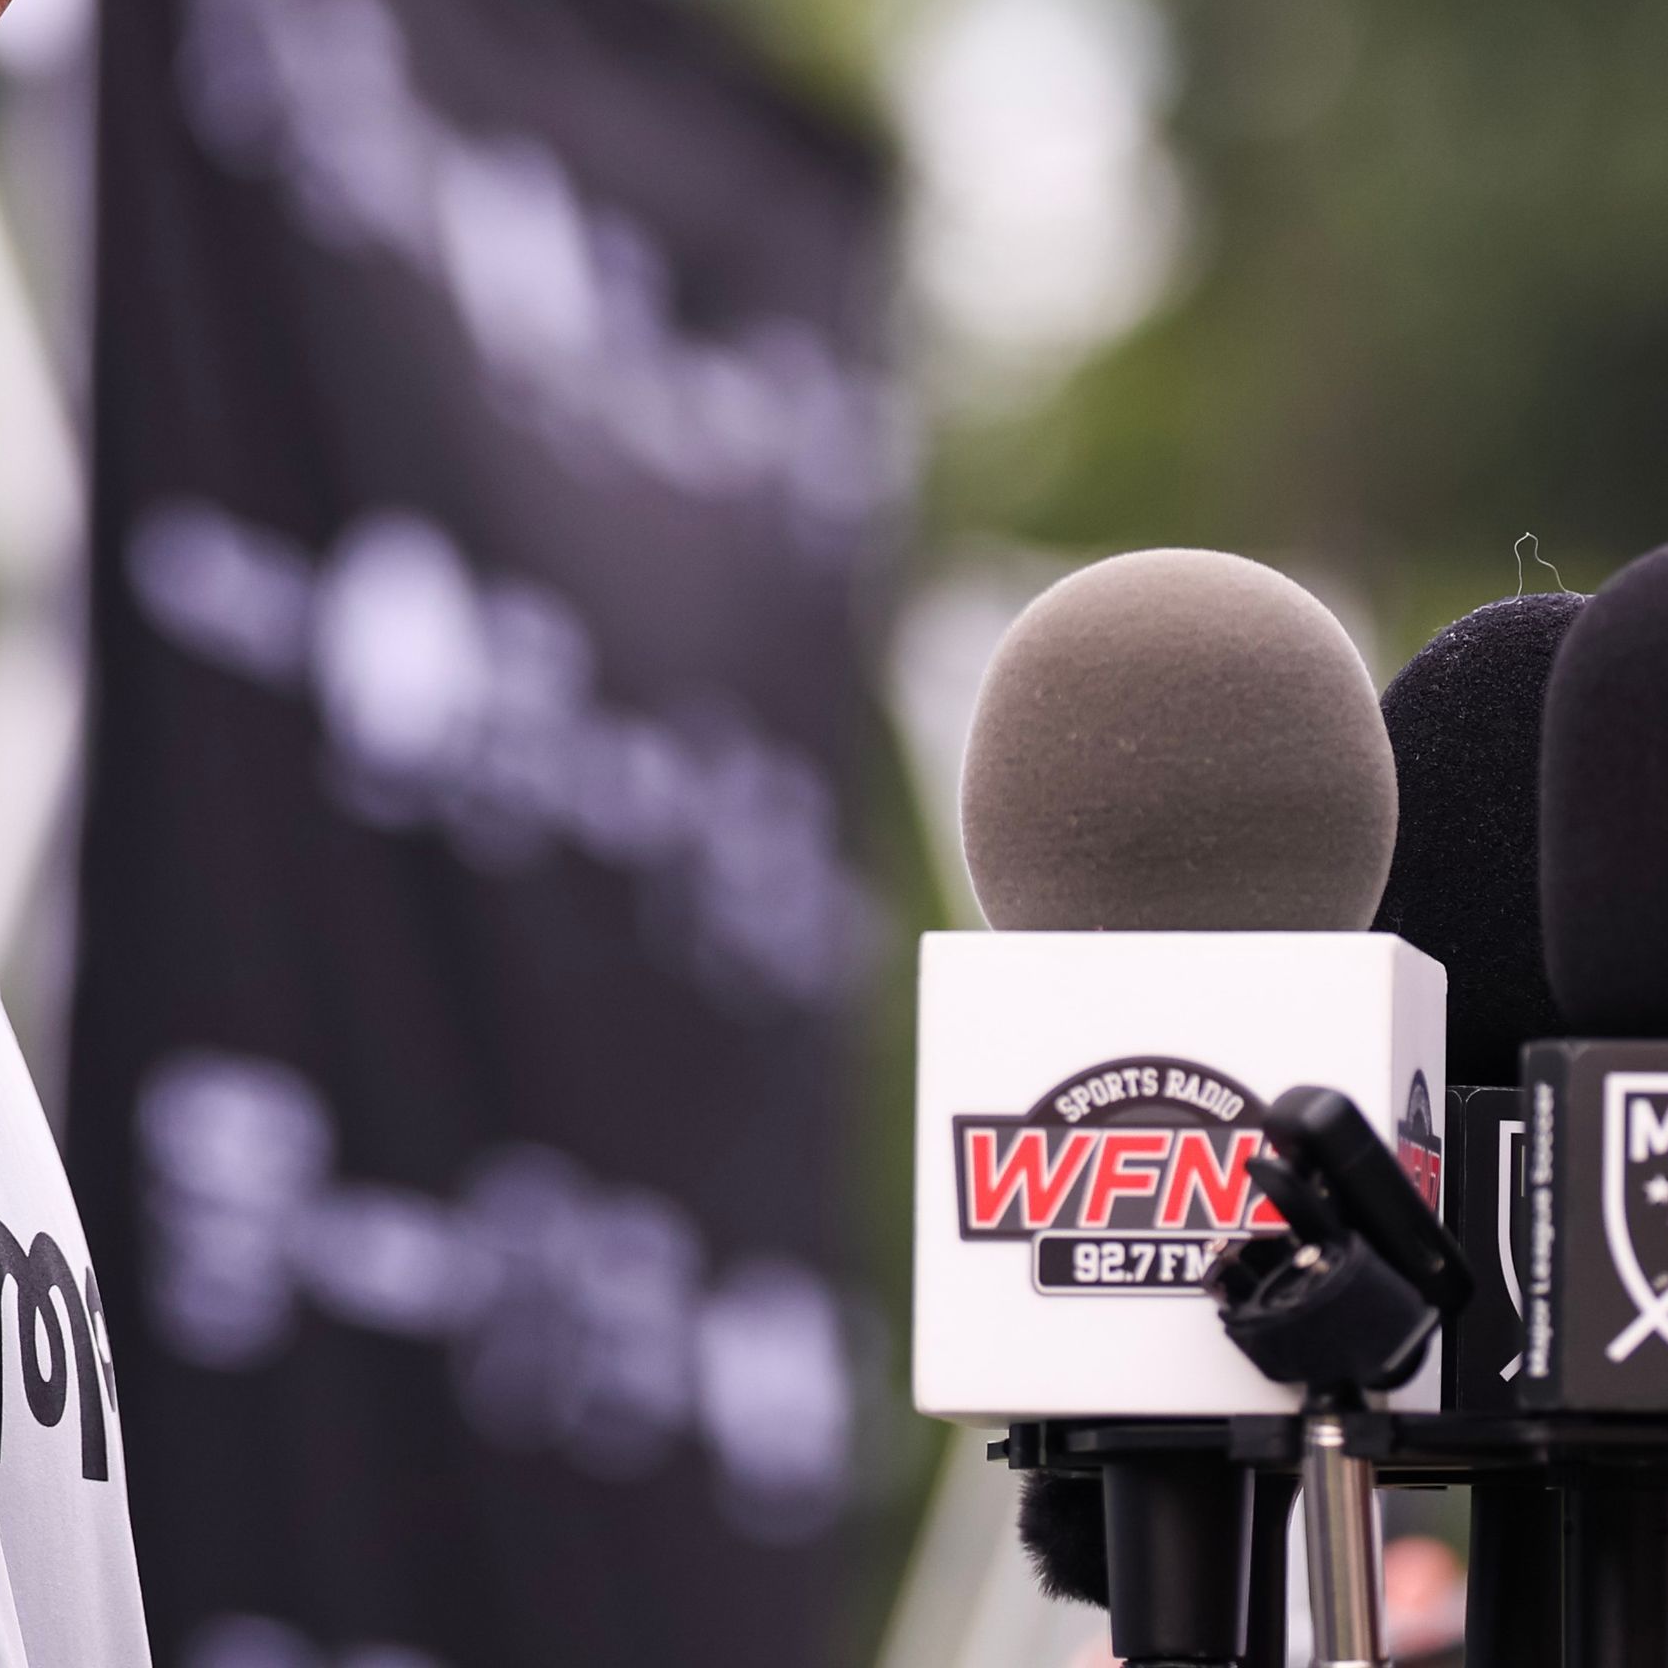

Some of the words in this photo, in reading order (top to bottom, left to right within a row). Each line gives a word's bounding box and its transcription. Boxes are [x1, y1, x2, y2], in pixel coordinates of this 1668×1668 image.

[1054, 1066, 1159, 1123] SPORTS
[1163, 1067, 1245, 1122] RADIO
[1530, 1082, 1555, 1185] Soccer
[1073, 1242, 1157, 1283] 92.7
[1530, 1188, 1555, 1296] League
[1528, 1299, 1554, 1379] Major
